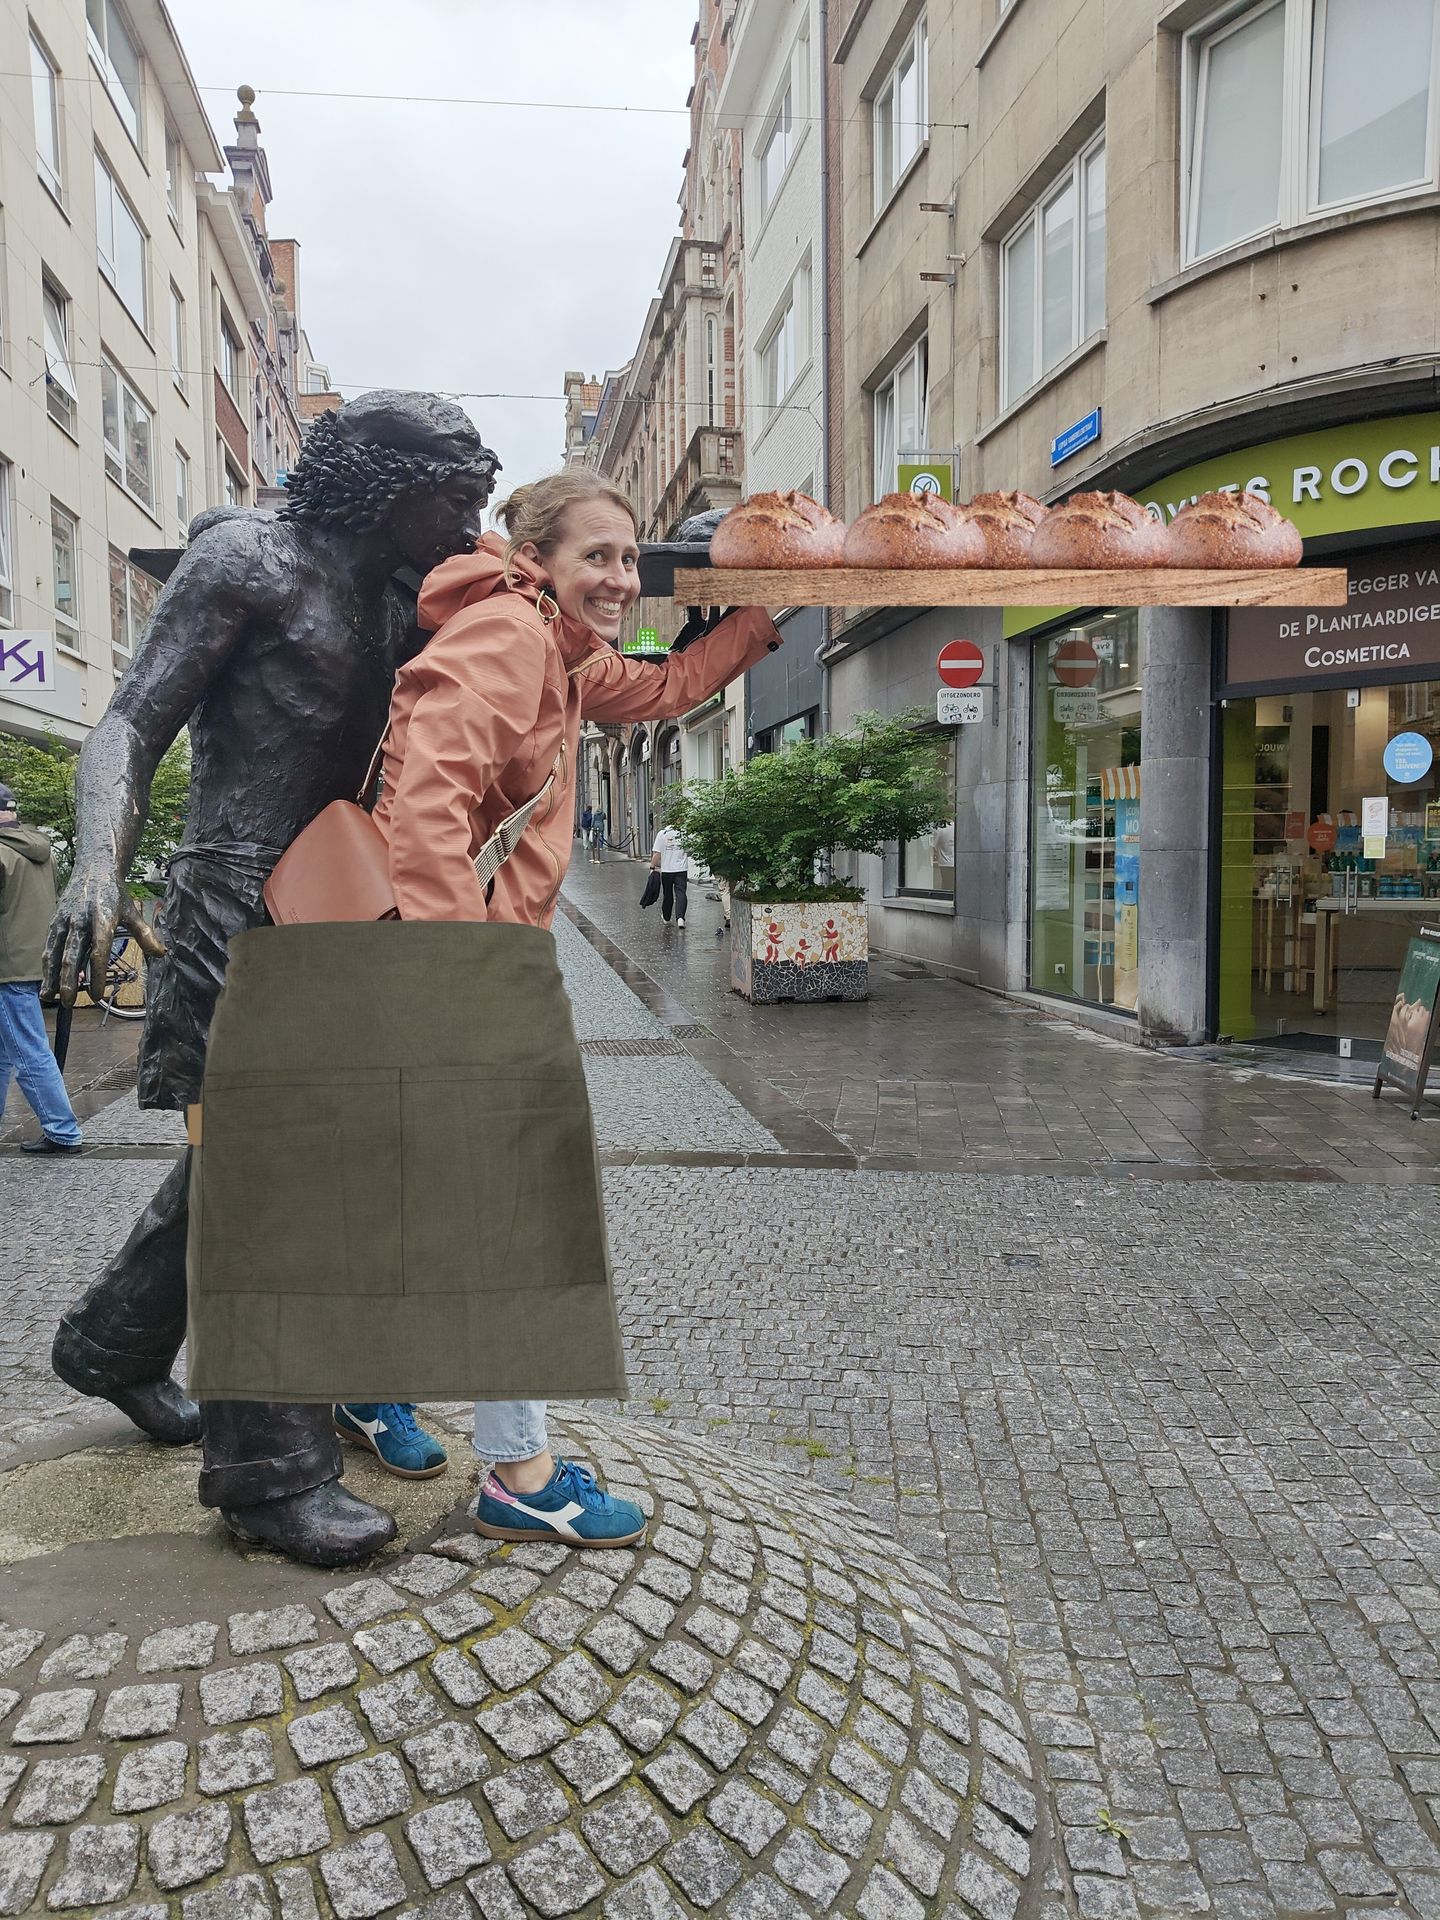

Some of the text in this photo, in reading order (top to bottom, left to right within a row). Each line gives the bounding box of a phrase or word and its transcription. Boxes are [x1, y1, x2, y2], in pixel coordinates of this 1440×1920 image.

[1293, 446, 1440, 503] ROC
[1348, 569, 1439, 596] EGGER VA
